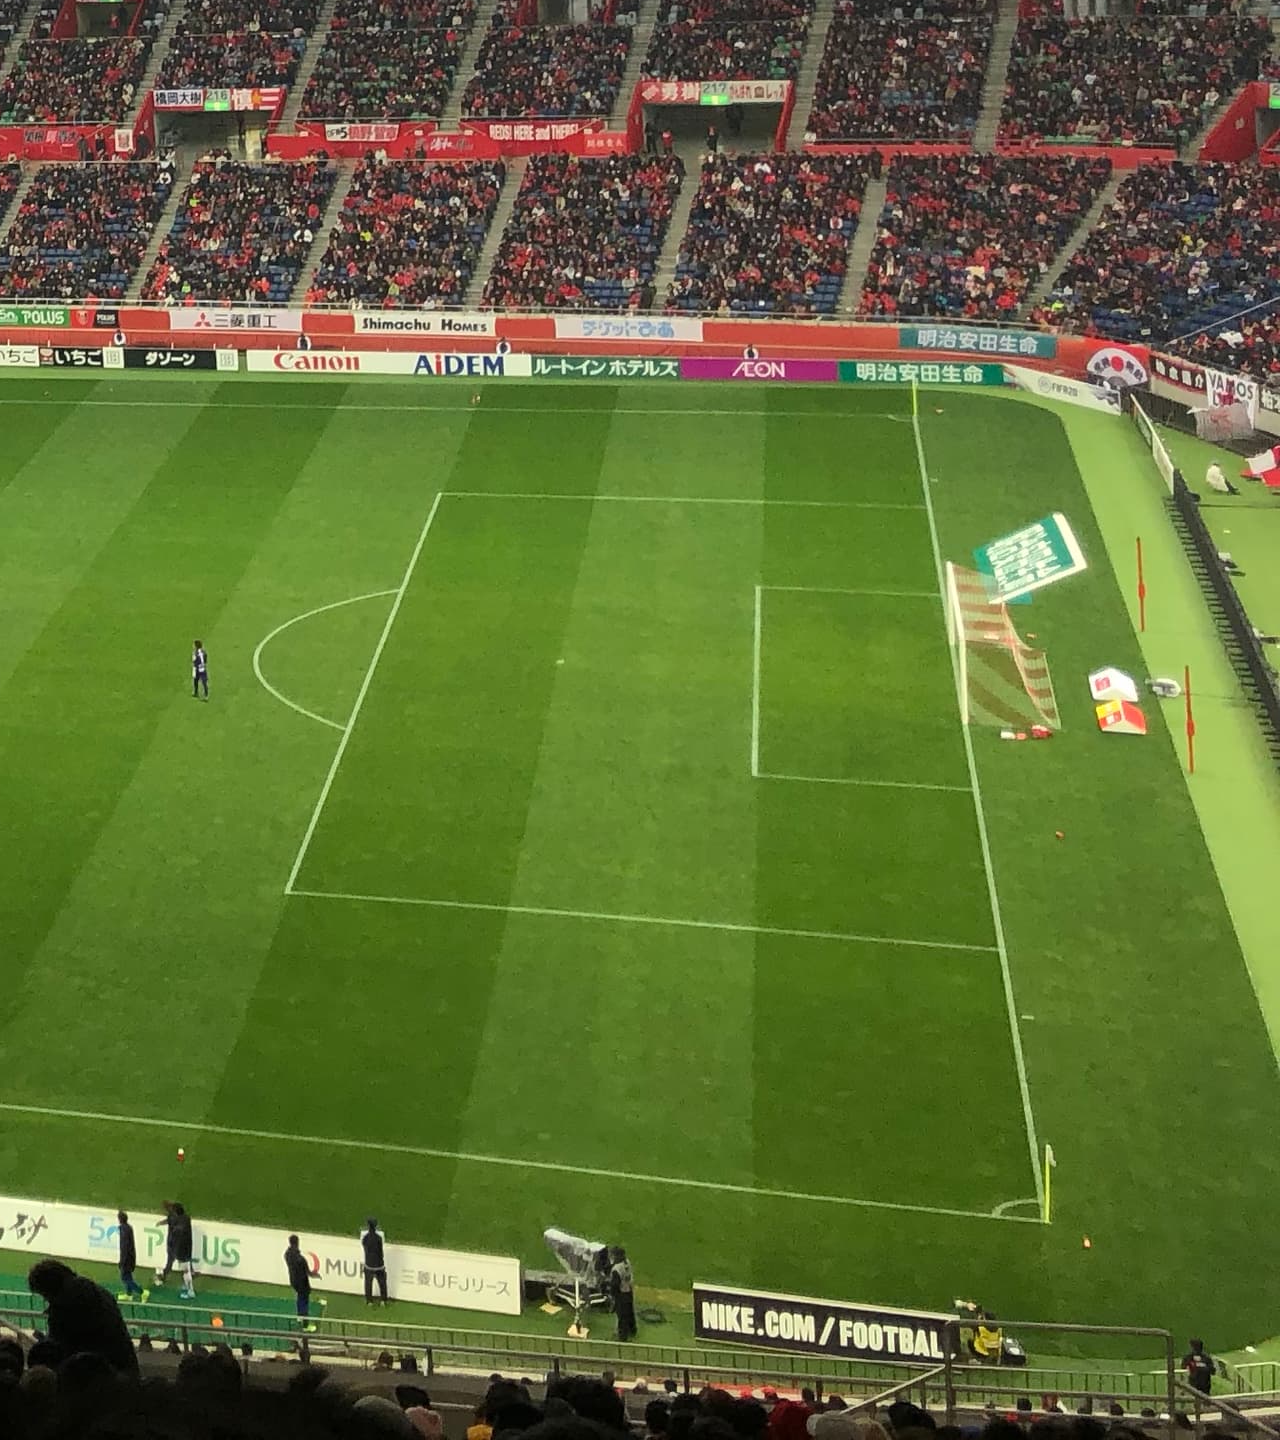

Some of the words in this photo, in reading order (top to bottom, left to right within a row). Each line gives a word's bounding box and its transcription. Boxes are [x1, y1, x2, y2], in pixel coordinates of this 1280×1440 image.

[206, 90, 228, 101] 216
[703, 83, 727, 94] 217
[155, 91, 202, 106] 橋岡大樹
[489, 124, 512, 140] REDS!
[513, 124, 534, 140] HERE
[535, 125, 550, 140] and
[21, 310, 65, 325] POLUS
[214, 313, 278, 328] 三菱重工
[362, 317, 431, 330] Shimachu
[583, 320, 675, 337] チケットぴあ
[917, 330, 1038, 353] 明治安田生命
[55, 348, 102, 365] いちご
[273, 353, 361, 371] Canon
[856, 362, 984, 384] 明治安田生命
[401, 1268, 511, 1297] 三菱UFJリース
[701, 1301, 956, 1360] NIKE.COM/FOOTBAL
